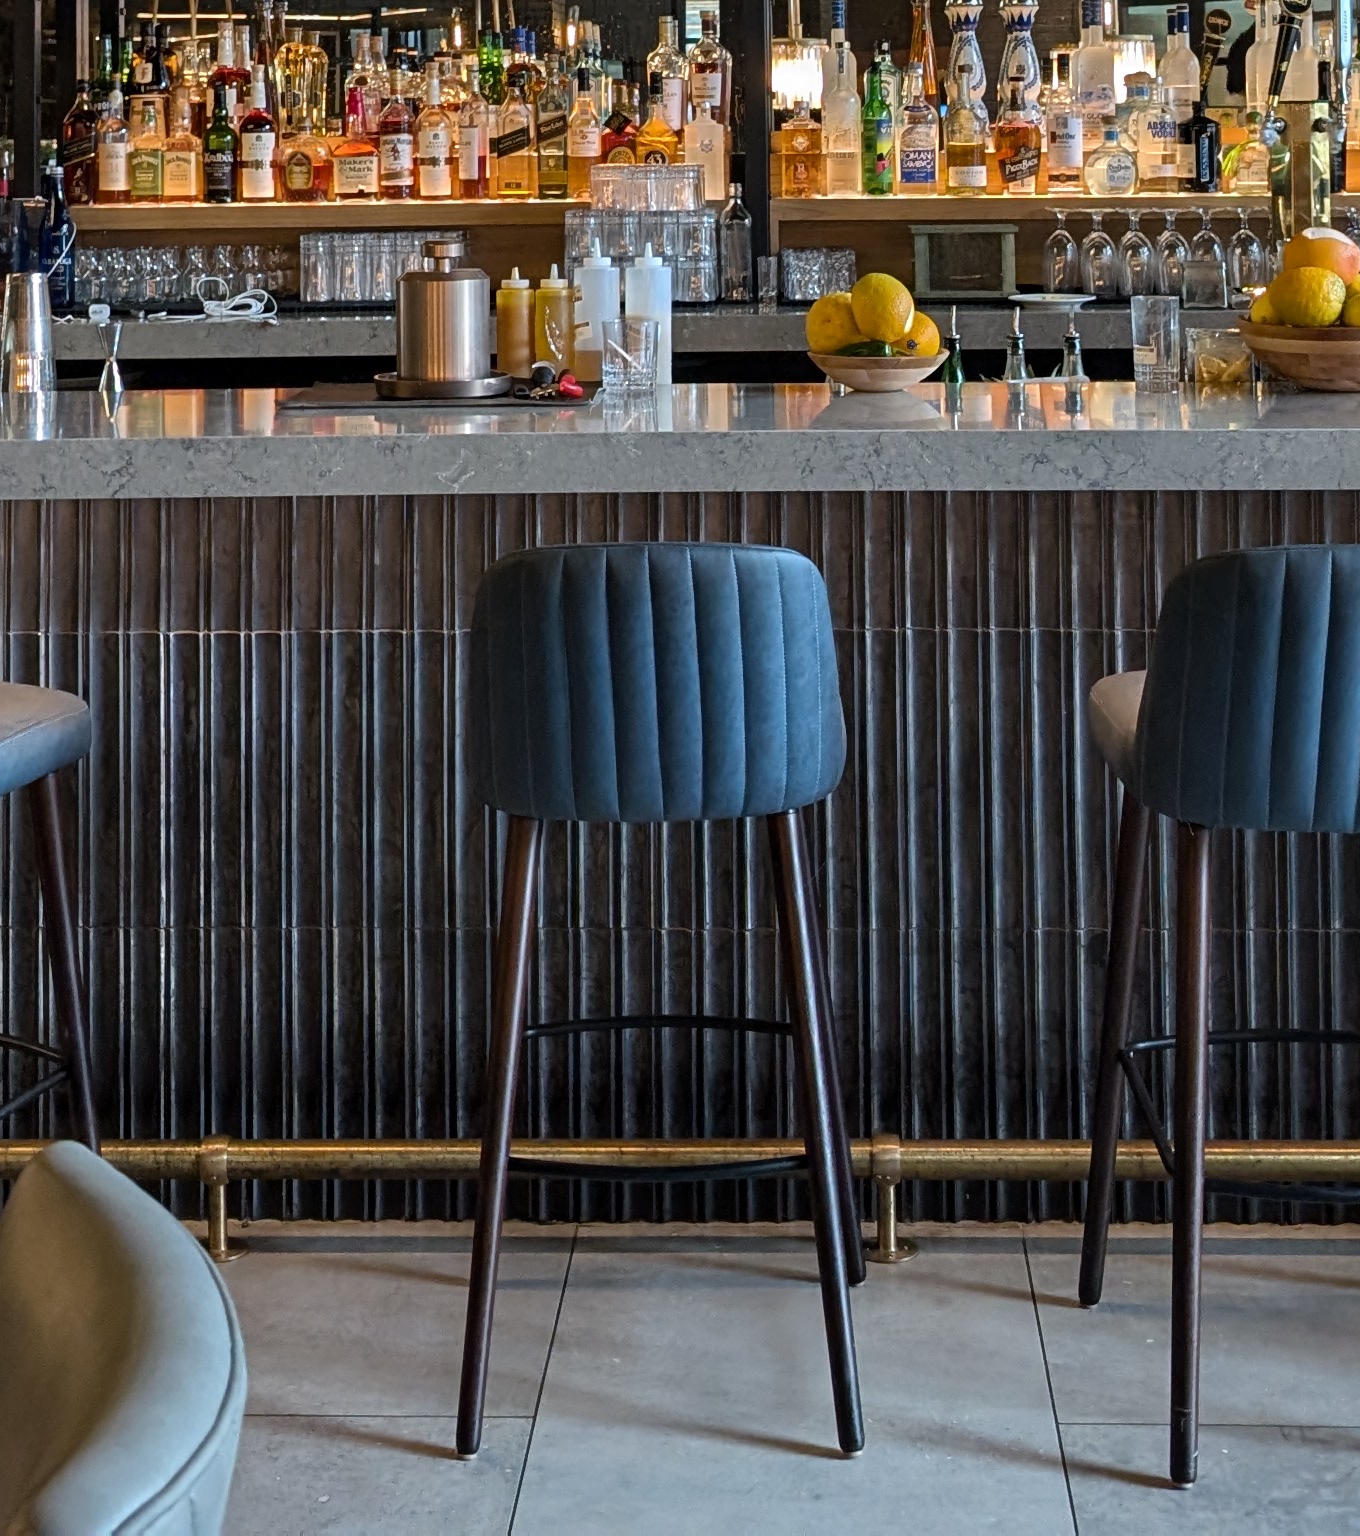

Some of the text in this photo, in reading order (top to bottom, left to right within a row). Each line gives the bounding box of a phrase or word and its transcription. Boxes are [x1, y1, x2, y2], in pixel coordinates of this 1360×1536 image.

[646, 154, 663, 163] 43
[338, 159, 374, 167] Maker's
[350, 165, 373, 173] Mark
